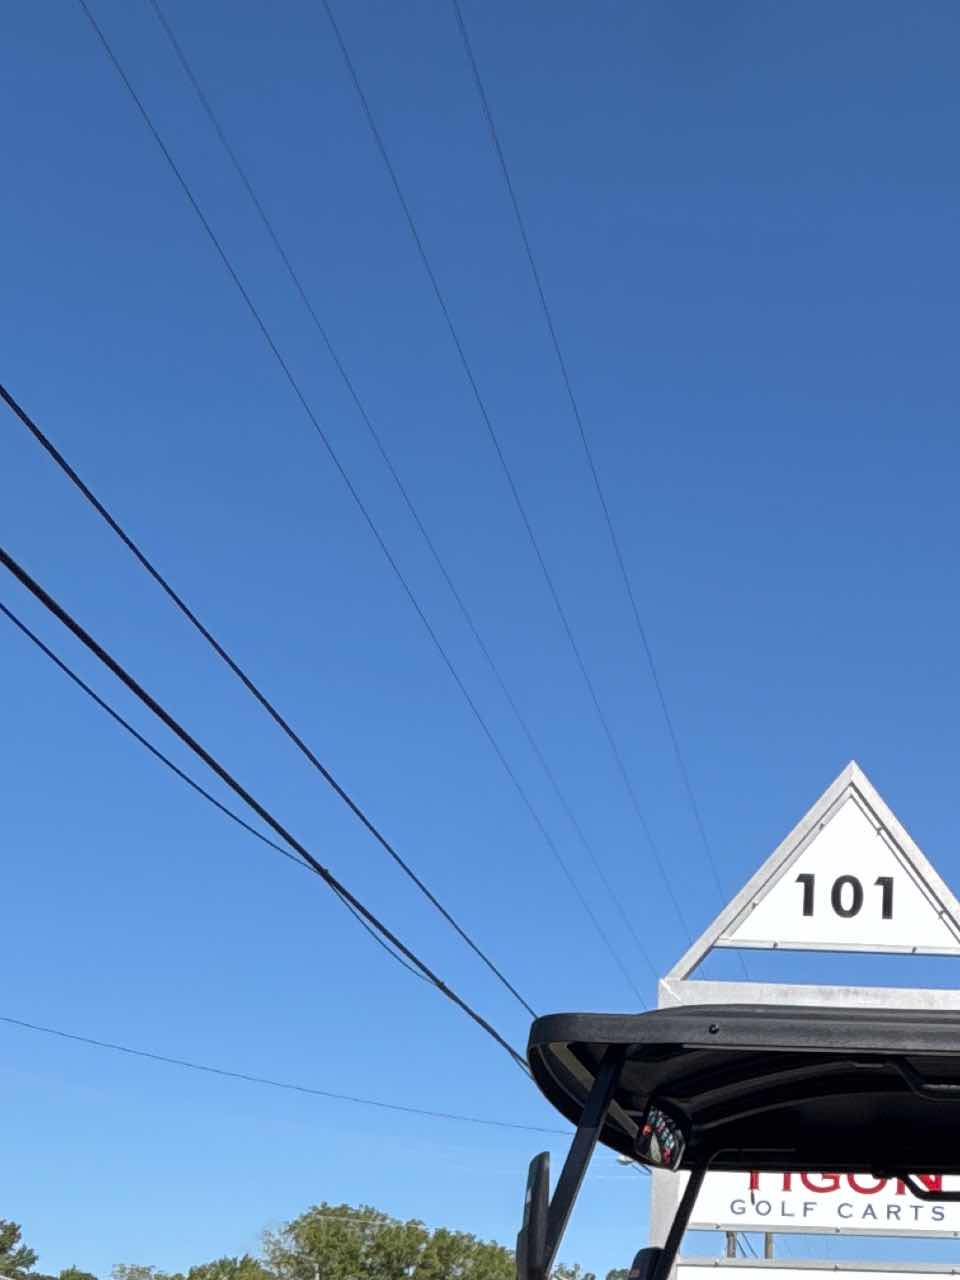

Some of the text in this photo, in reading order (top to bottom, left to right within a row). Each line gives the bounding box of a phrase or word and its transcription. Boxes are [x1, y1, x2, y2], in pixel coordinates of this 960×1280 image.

[795, 872, 894, 920] 101
[729, 1198, 946, 1222] GOLF CARTS
